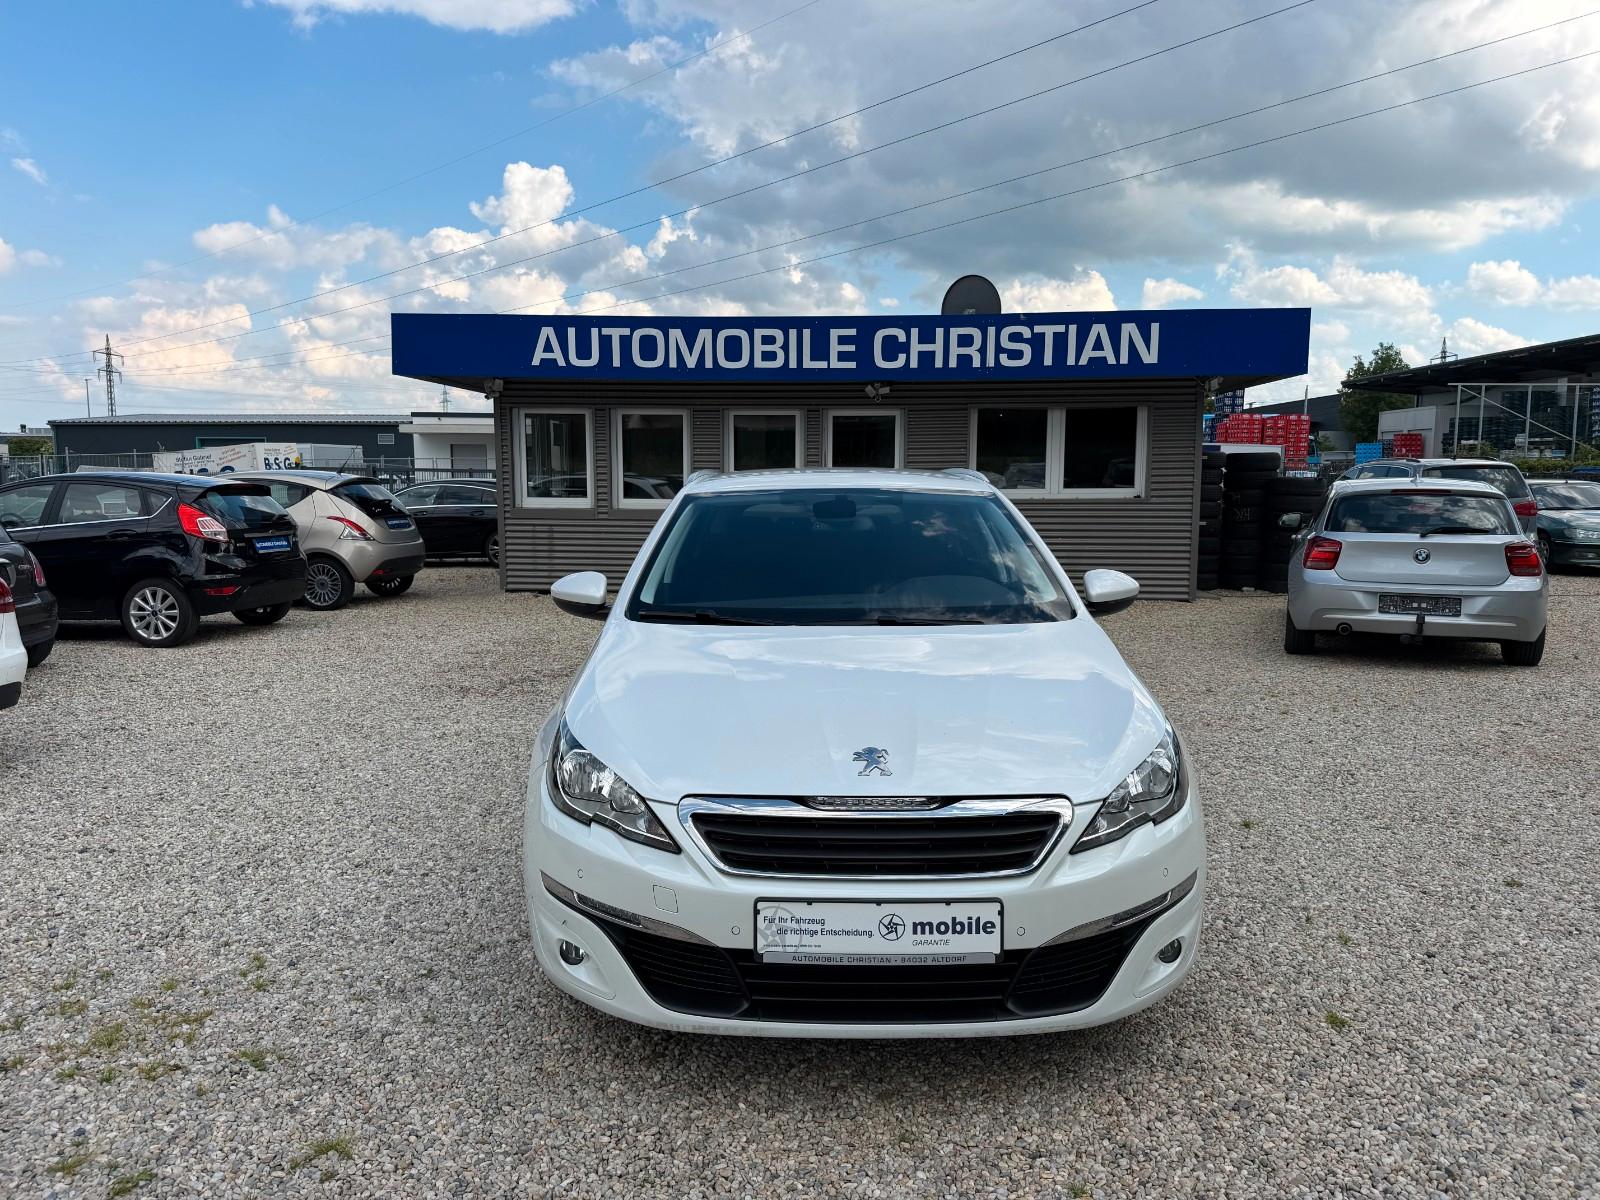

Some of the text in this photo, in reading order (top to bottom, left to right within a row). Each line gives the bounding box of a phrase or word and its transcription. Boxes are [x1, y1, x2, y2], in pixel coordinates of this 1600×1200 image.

[532, 322, 1160, 370] AUTOMOBILE CHRISTIAN
[763, 915, 826, 927] Für Ihr Fahrzeug
[912, 916, 997, 936] mobile
[776, 927, 875, 939] die richtige Entscheidung.
[912, 939, 951, 947] GARANTIE
[791, 955, 845, 963] AUTOMOBILE
[847, 956, 892, 965] CHRISTIAN
[931, 955, 967, 963] ALTDORF
